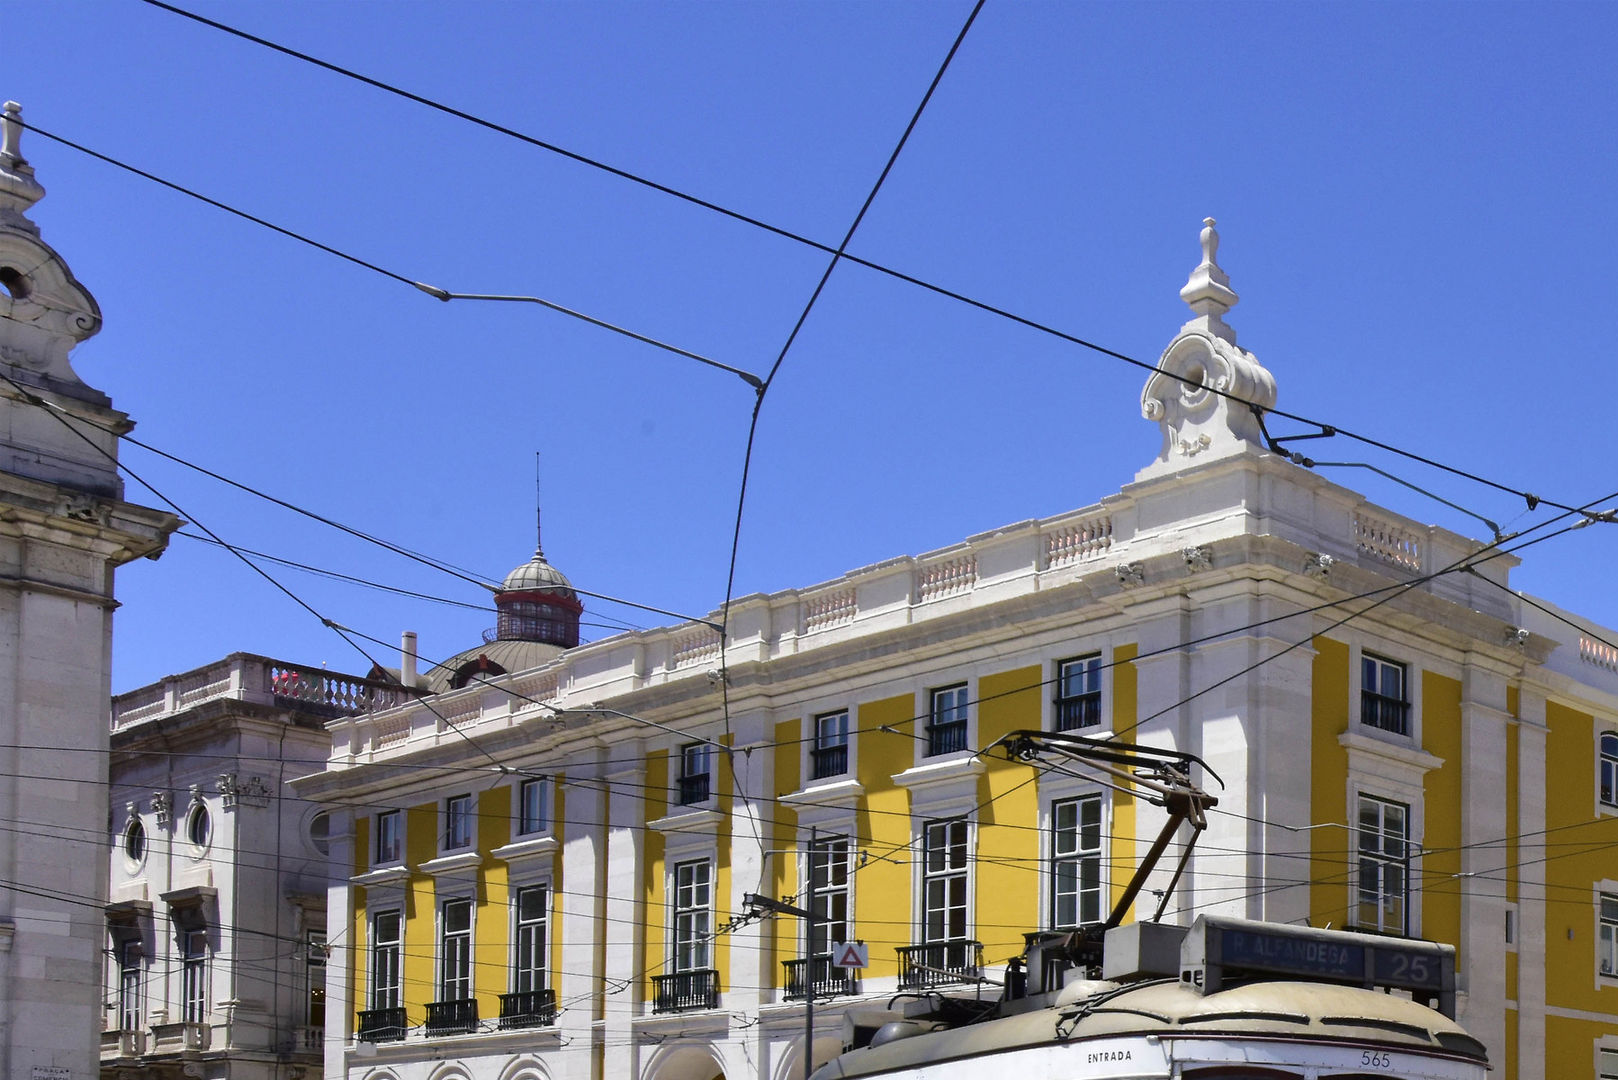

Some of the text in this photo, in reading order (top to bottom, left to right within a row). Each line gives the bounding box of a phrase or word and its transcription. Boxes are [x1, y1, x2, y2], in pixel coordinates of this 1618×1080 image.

[1391, 955, 1429, 982] 25
[1088, 1050, 1132, 1064] ENTRADA
[1361, 1051, 1391, 1068] 565
